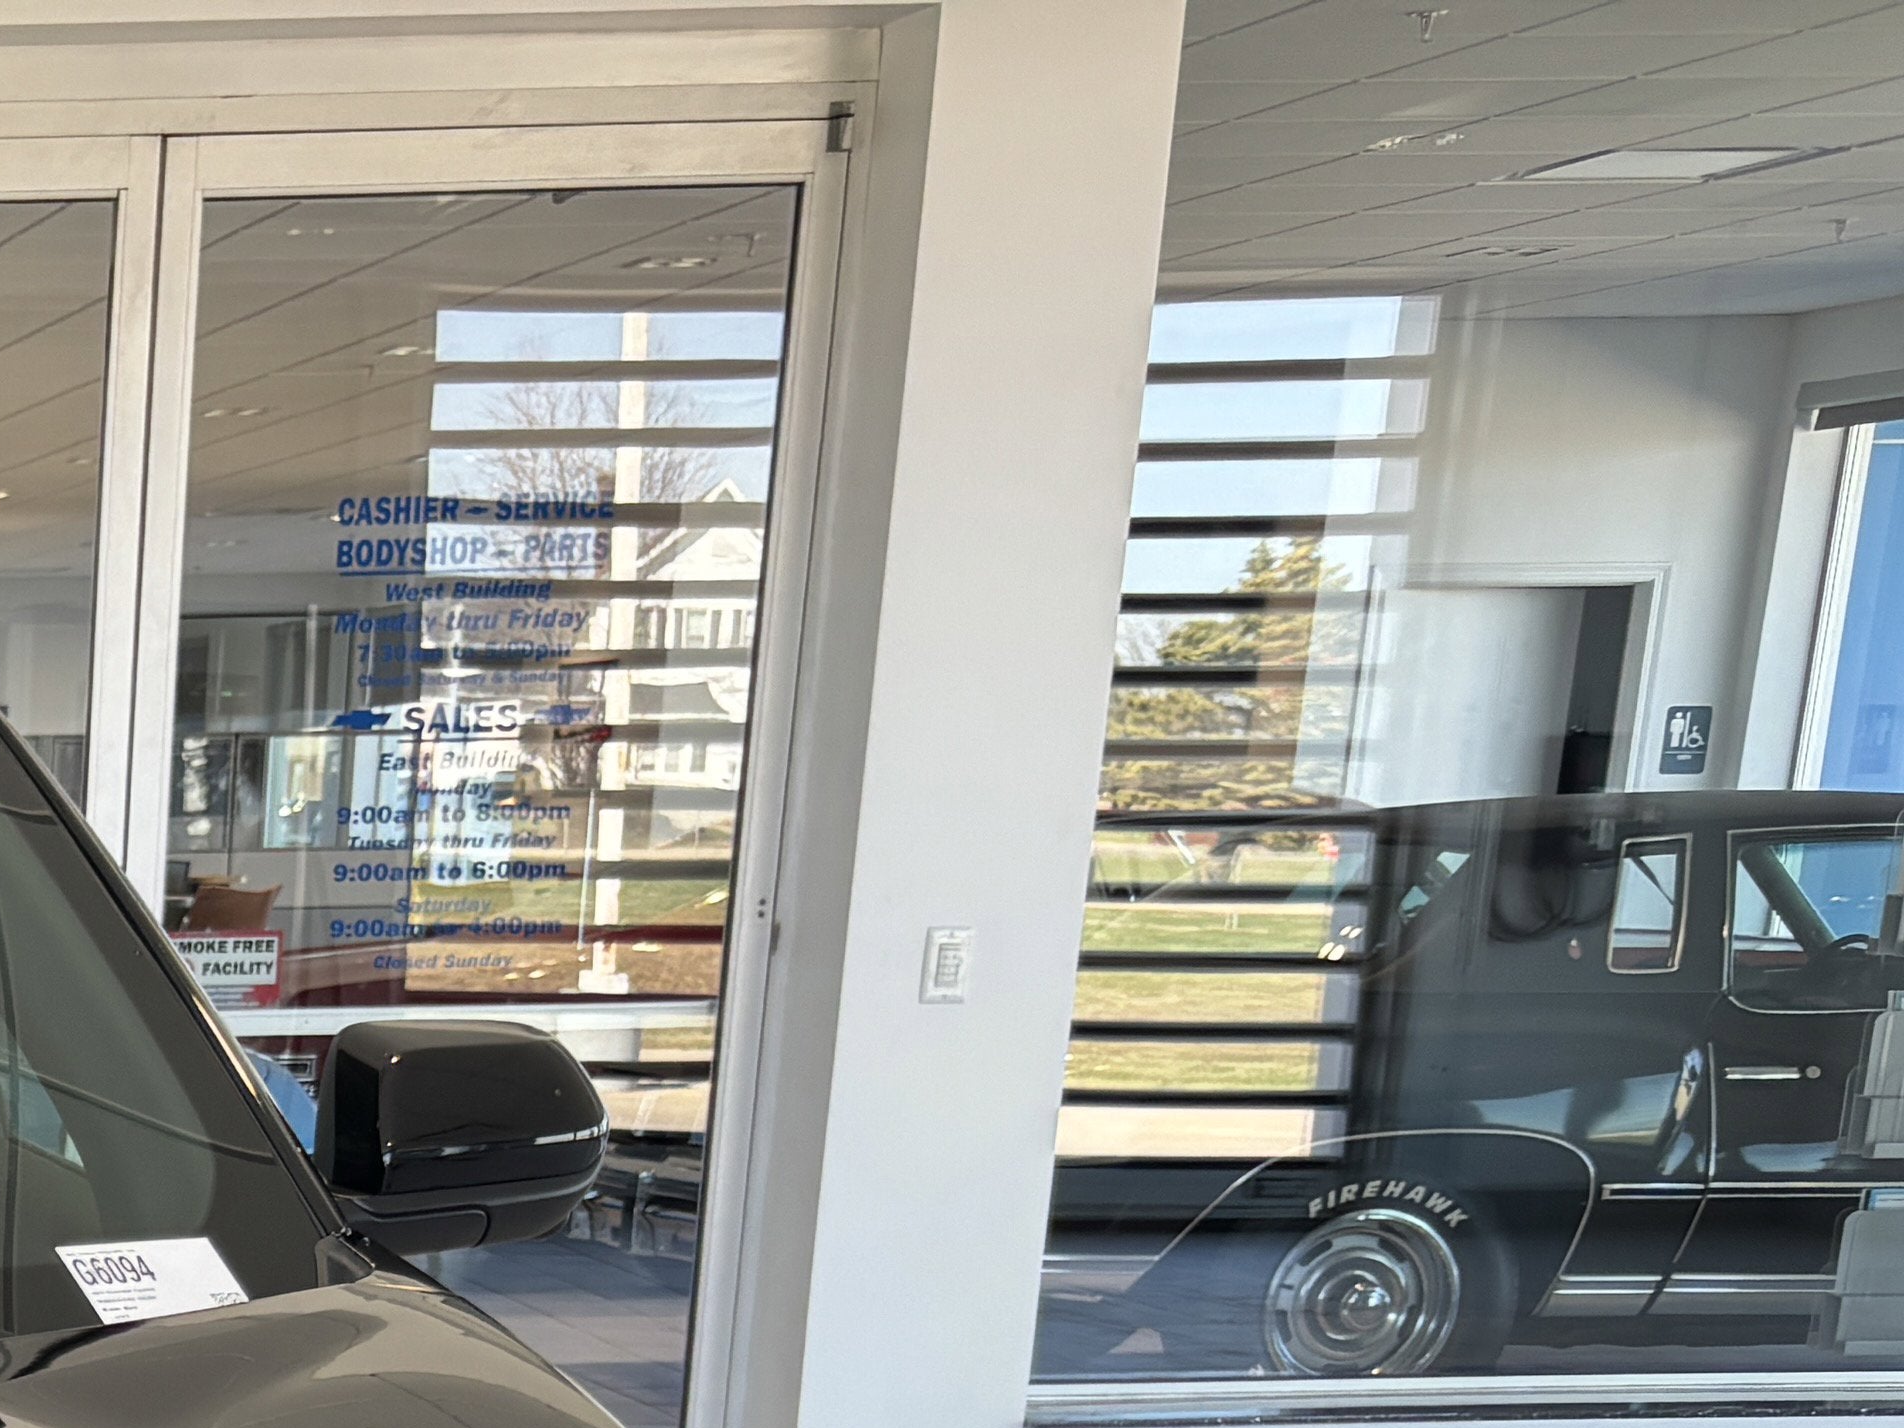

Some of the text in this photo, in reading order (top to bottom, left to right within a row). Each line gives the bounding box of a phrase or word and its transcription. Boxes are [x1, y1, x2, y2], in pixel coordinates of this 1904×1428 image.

[338, 489, 613, 526] CASHIER SERVICE
[336, 532, 610, 568] BODYSHOP PARTS
[385, 580, 552, 602] West Building
[334, 608, 590, 634] Monday thru Friday
[404, 704, 518, 735] SALES
[379, 750, 431, 771] East
[337, 801, 571, 826] 9:00am to 8:00pm
[442, 832, 484, 849] thru
[492, 831, 556, 851] Friday
[333, 859, 566, 883] 9:00am to 6:00pm
[330, 918, 429, 938] 9:00am
[232, 939, 275, 953] FREE
[201, 961, 274, 976] FACILITY
[373, 953, 513, 970] Closed Sunday
[1308, 1180, 1469, 1228] FIREHAWK
[72, 1255, 157, 1286] G6094
